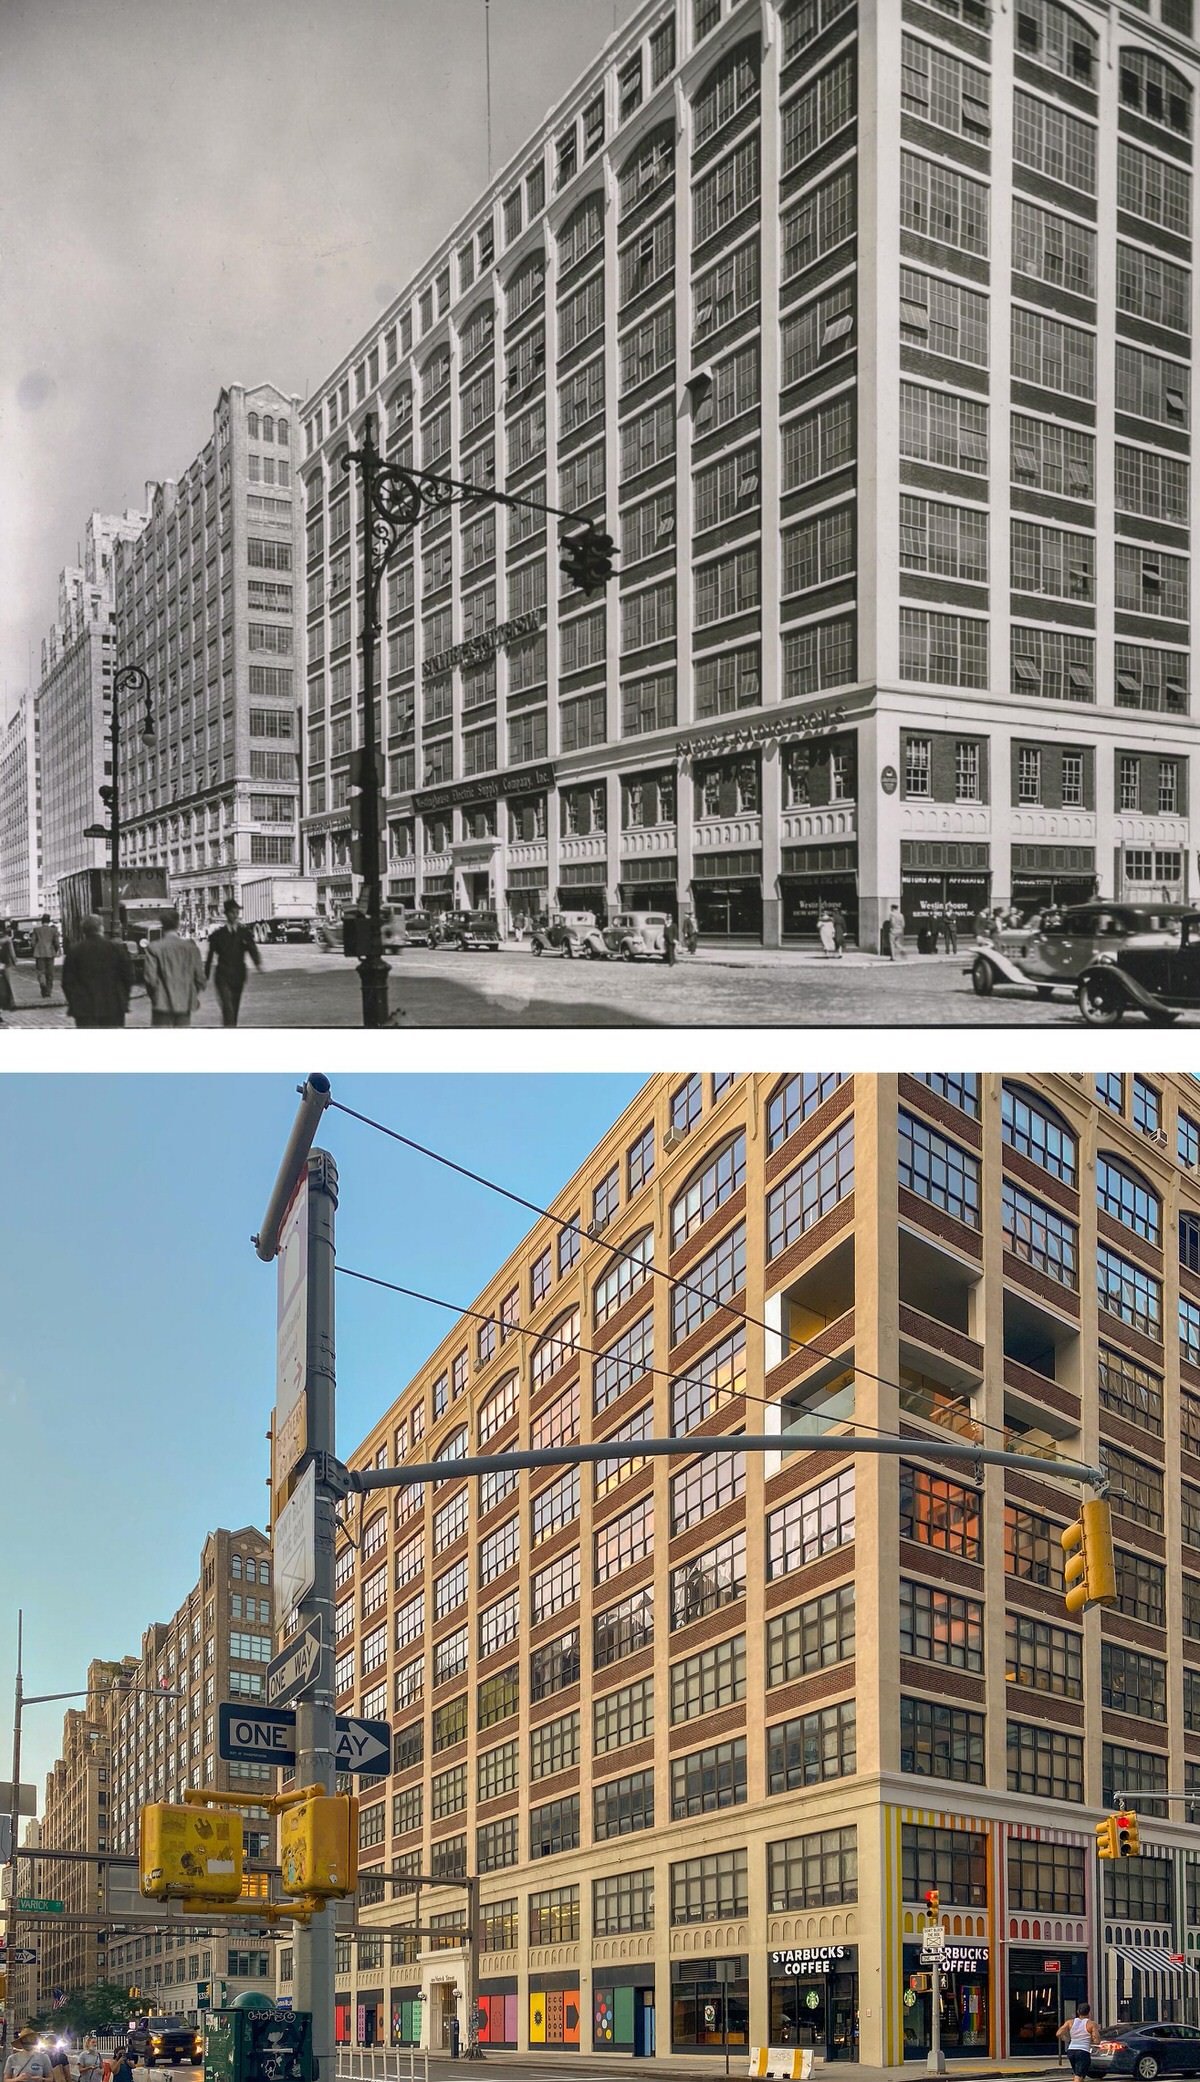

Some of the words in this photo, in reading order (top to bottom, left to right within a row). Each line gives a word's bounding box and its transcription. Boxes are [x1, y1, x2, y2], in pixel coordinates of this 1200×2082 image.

[477, 781, 499, 799] Supply
[536, 770, 550, 784] Inc.
[270, 1667, 286, 1698] ONE
[294, 1641, 313, 1677] WAY
[235, 1722, 287, 1748] ONE
[336, 1734, 369, 1757] AY
[20, 1899, 49, 1910] VARICK
[772, 1946, 844, 1963] STARBUCKS
[922, 1947, 989, 1960] RBUCKS
[784, 1961, 830, 1975] COFFEE
[938, 1960, 977, 1973] OFFEE
